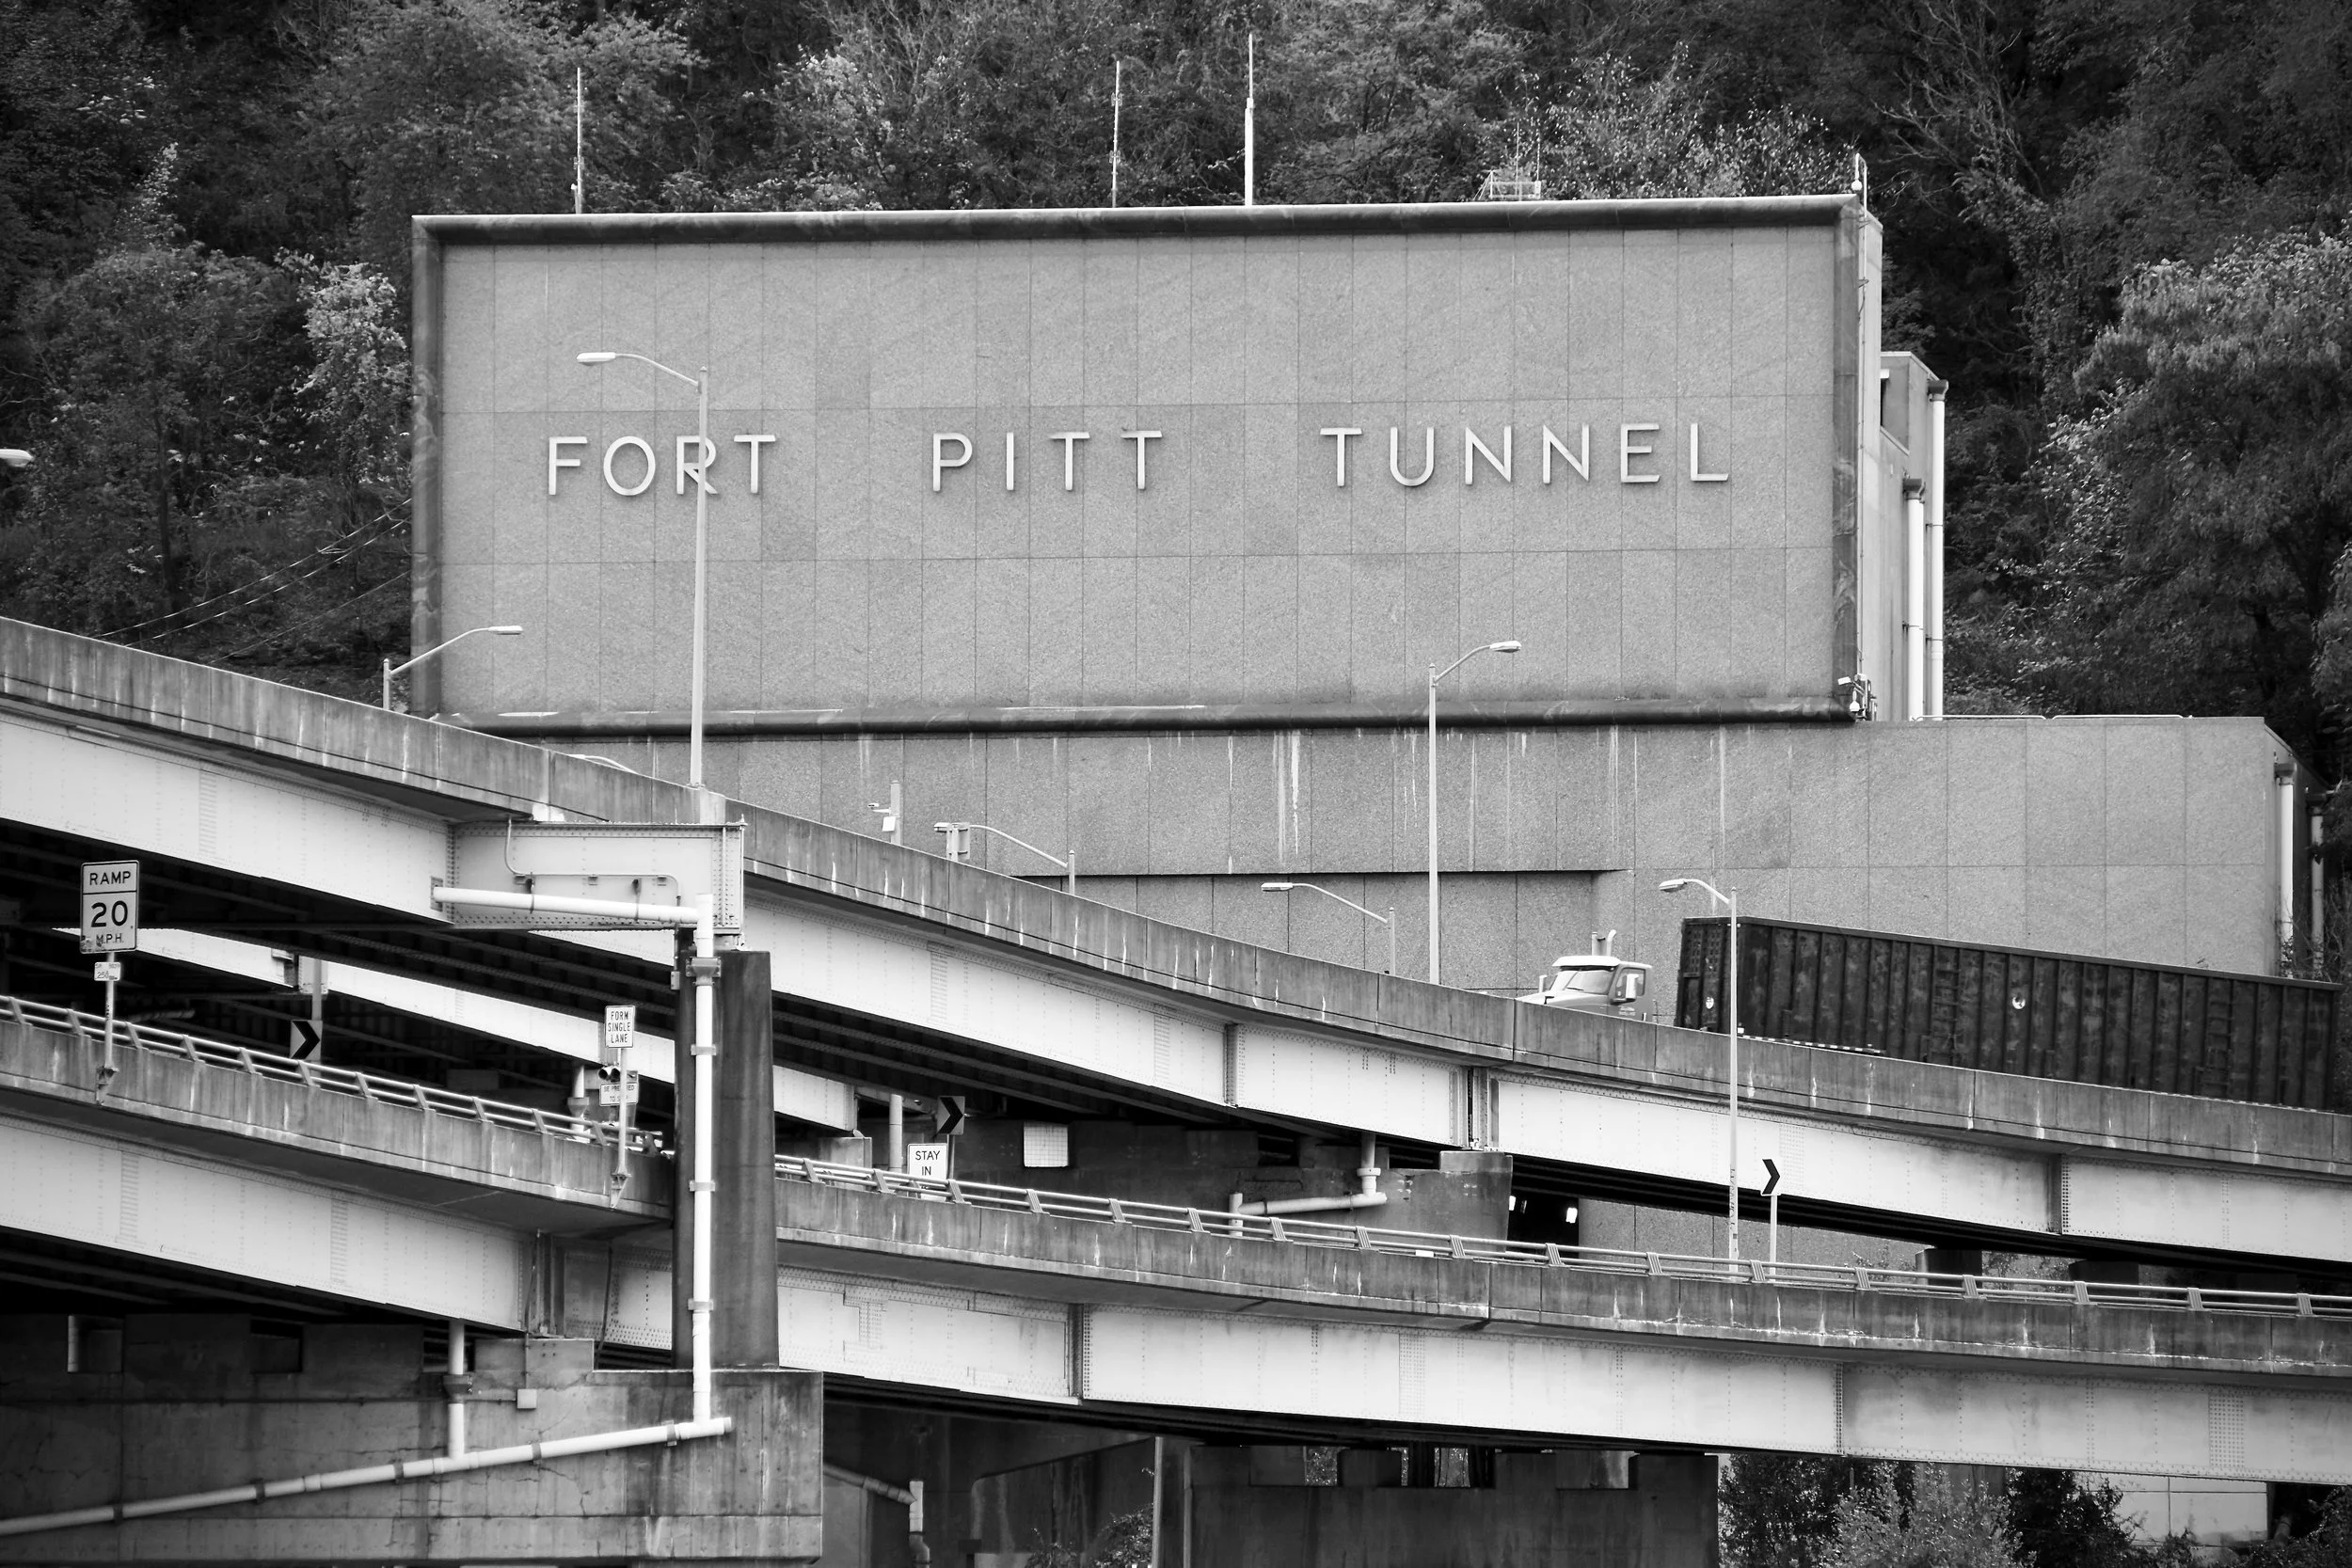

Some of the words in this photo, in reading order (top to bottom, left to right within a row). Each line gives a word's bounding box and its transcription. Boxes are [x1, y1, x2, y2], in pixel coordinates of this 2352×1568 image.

[548, 434, 776, 496] FORT
[931, 430, 1163, 492] PITT
[1320, 422, 1729, 487] TUNNEL
[89, 871, 131, 885] RAMP
[91, 900, 128, 927] 20
[611, 1011, 628, 1021] FORM
[608, 1022, 630, 1032] SINGLE
[611, 1034, 628, 1043] LANE
[915, 1150, 940, 1161] STAY
[921, 1166, 931, 1176] IN
